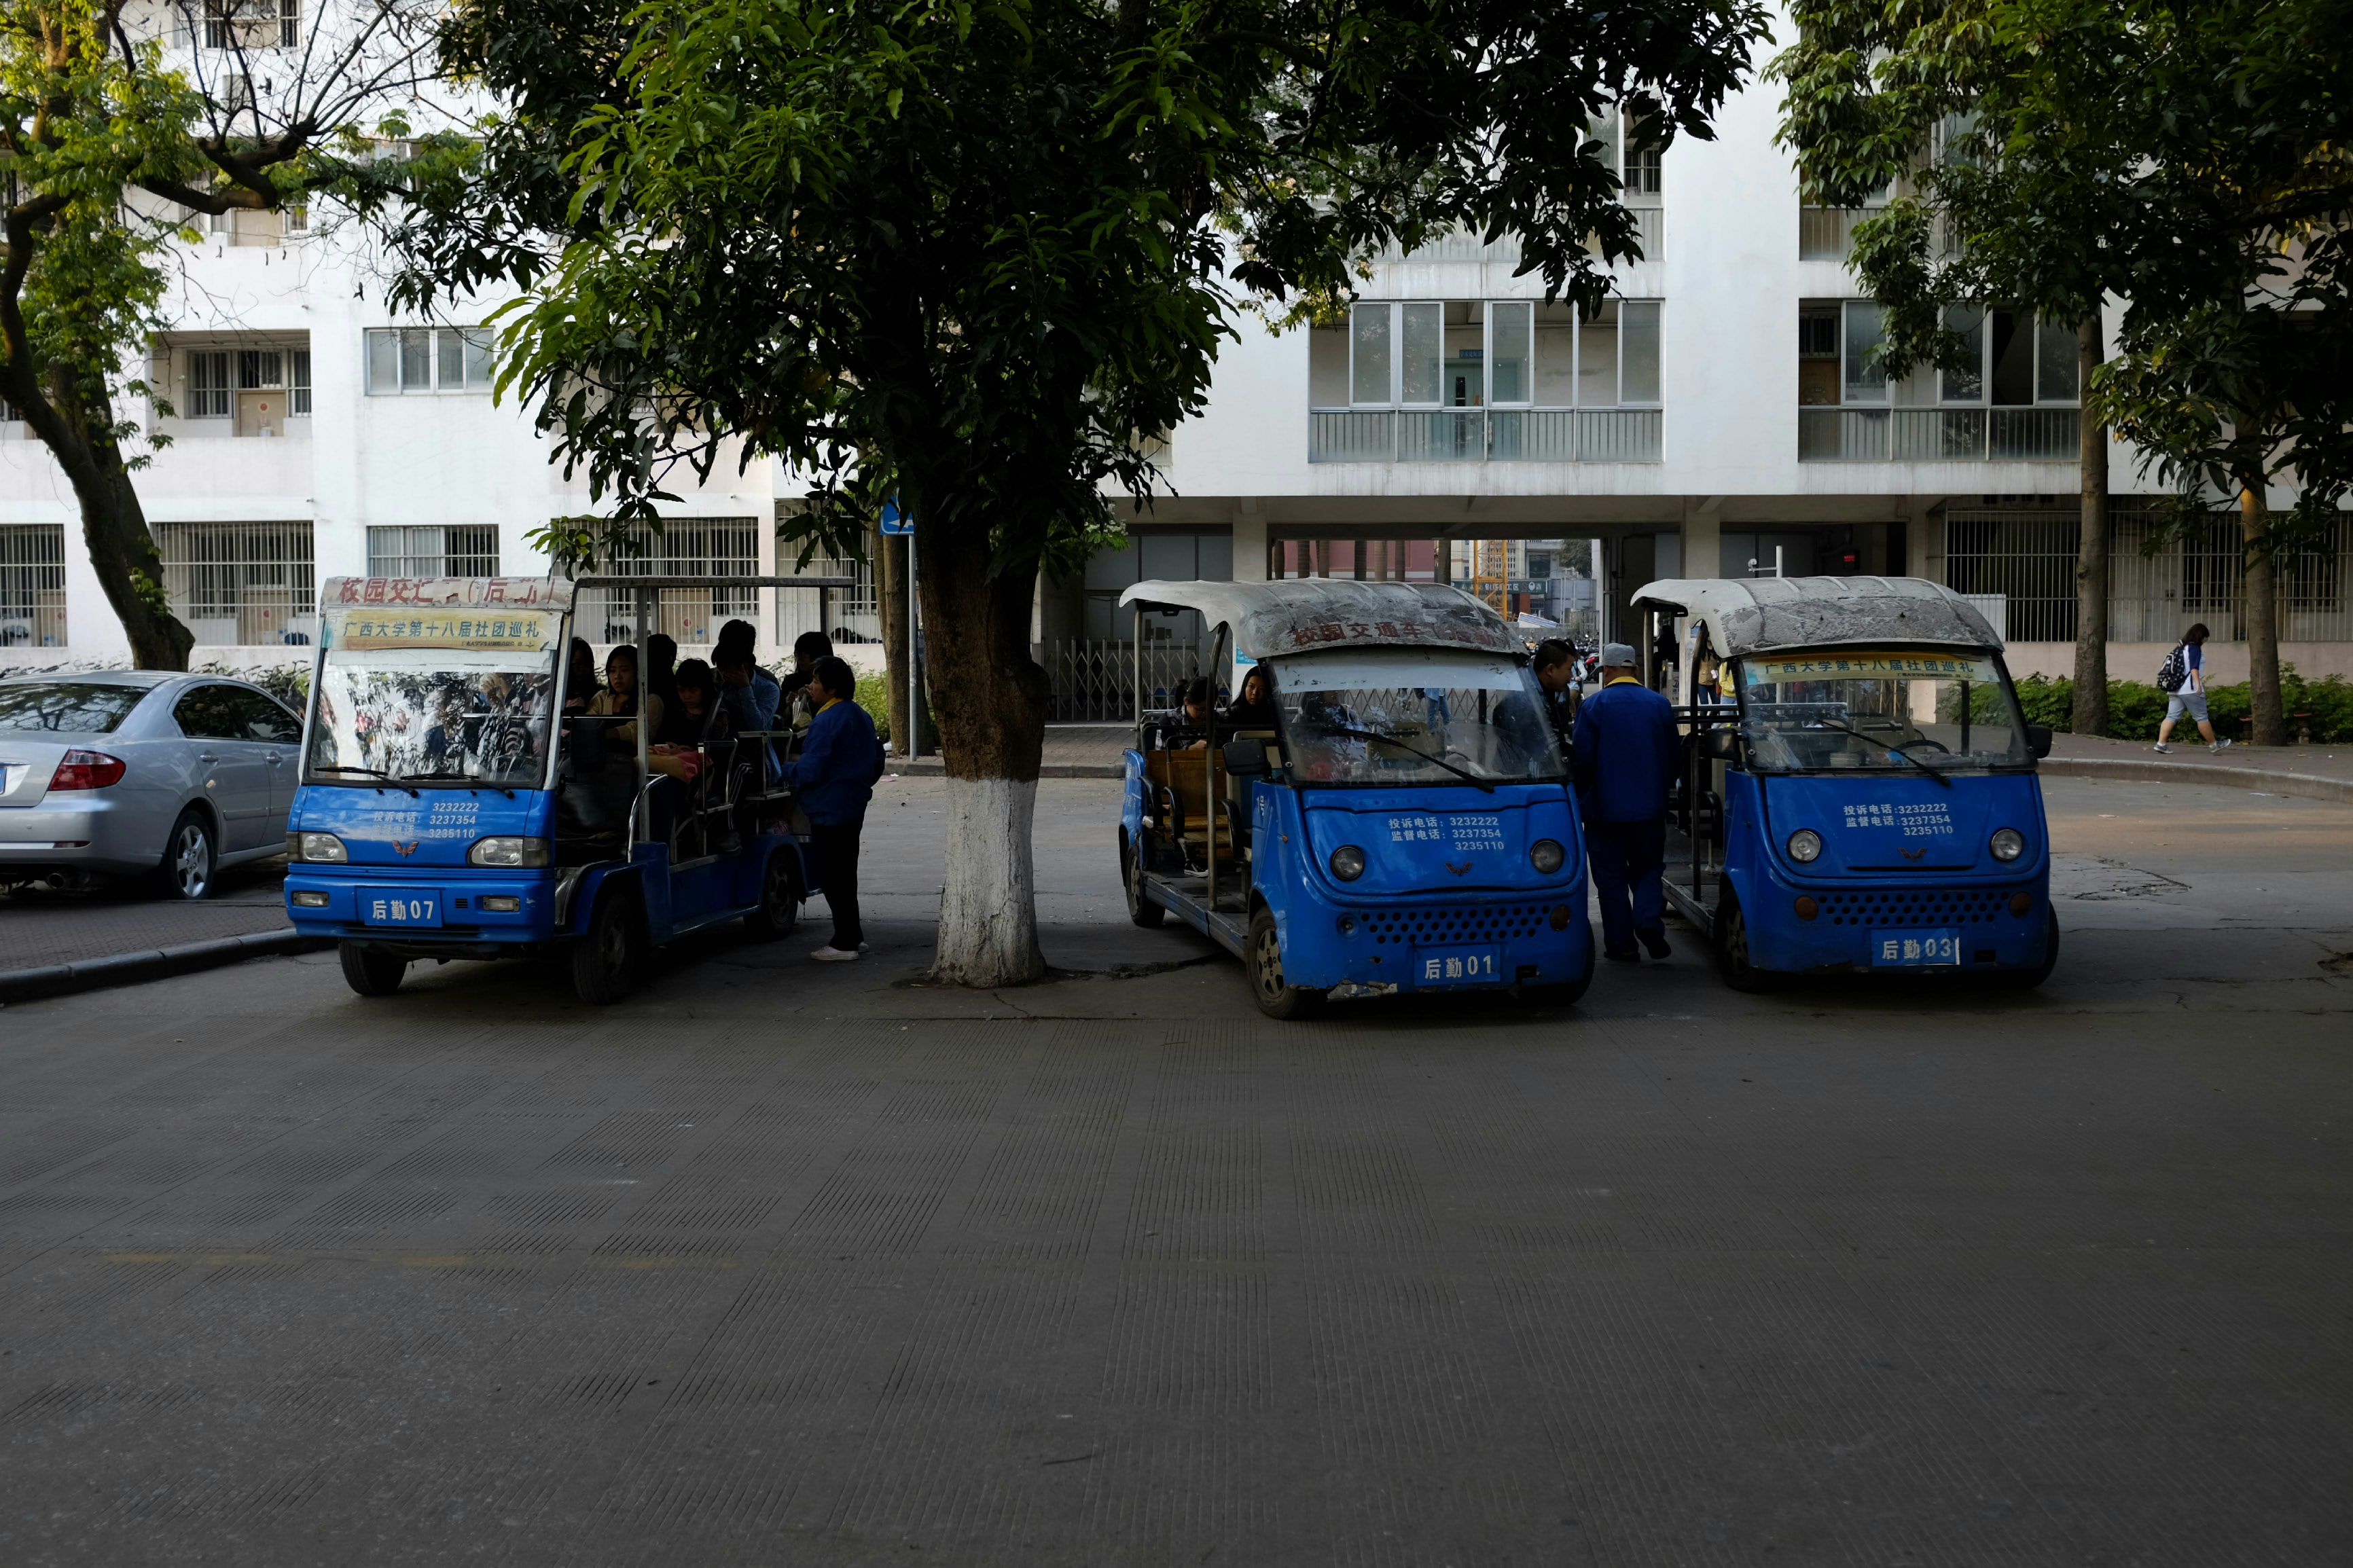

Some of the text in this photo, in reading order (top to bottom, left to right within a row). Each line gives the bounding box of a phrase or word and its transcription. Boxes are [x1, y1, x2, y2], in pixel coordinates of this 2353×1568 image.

[343, 621, 540, 638] 广西大学第十八届社团巡礼
[1765, 659, 1974, 674] 广西大学第十八届社团巡礼
[432, 803, 480, 813] 3232222
[429, 815, 476, 825] 3237354
[1450, 817, 1499, 826] 3232222
[429, 828, 475, 839] 3235110
[1452, 829, 1502, 838] 3237354
[1903, 825, 1954, 836] 3235110
[1454, 841, 1505, 850] 3235110
[372, 899, 434, 920] 后勤07
[1882, 938, 1952, 960] 后勤03
[1424, 955, 1492, 979] 后勤01
